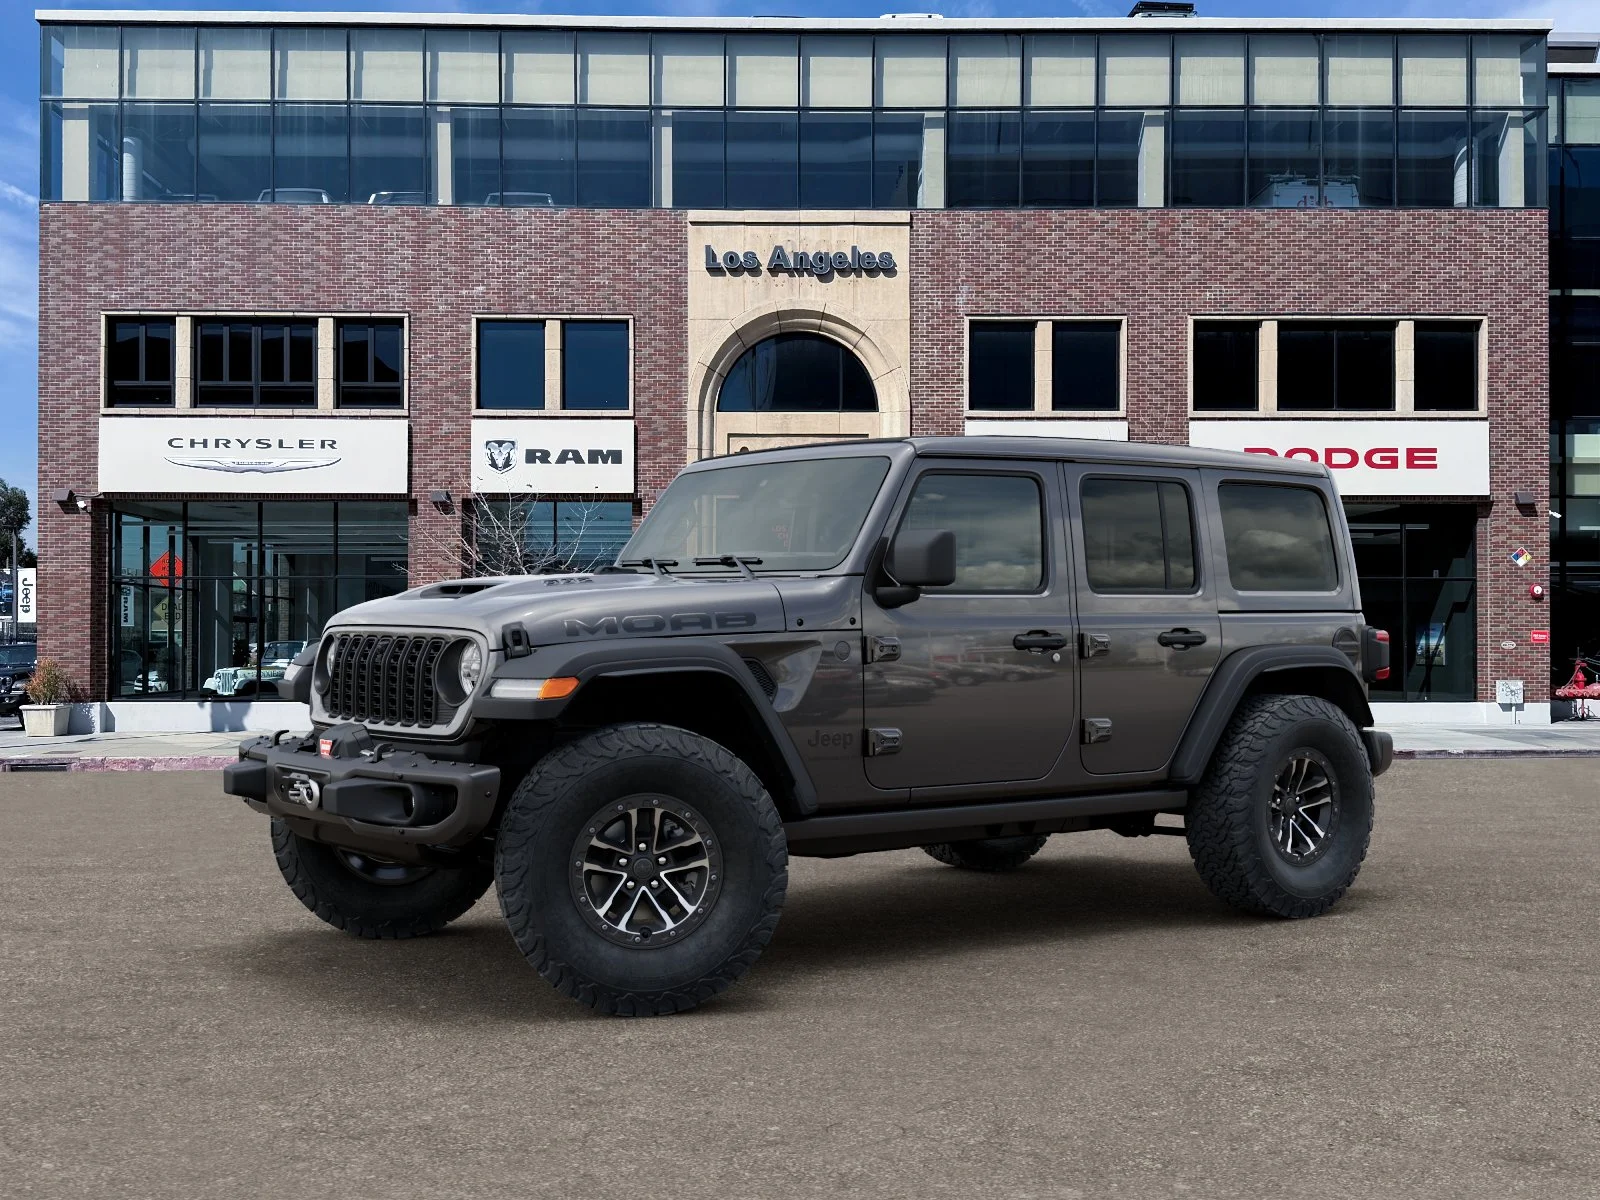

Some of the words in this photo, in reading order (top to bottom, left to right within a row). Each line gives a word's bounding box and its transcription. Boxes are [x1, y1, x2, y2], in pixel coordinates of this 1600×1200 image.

[705, 245, 758, 269] Los
[767, 245, 894, 275] Angeles
[168, 438, 338, 449] CHRYSLER
[525, 449, 622, 464] RAM
[1244, 447, 1438, 469] ODGE
[20, 577, 33, 613] Jeep
[564, 612, 757, 637] MOAB
[807, 729, 853, 750] Jeep
